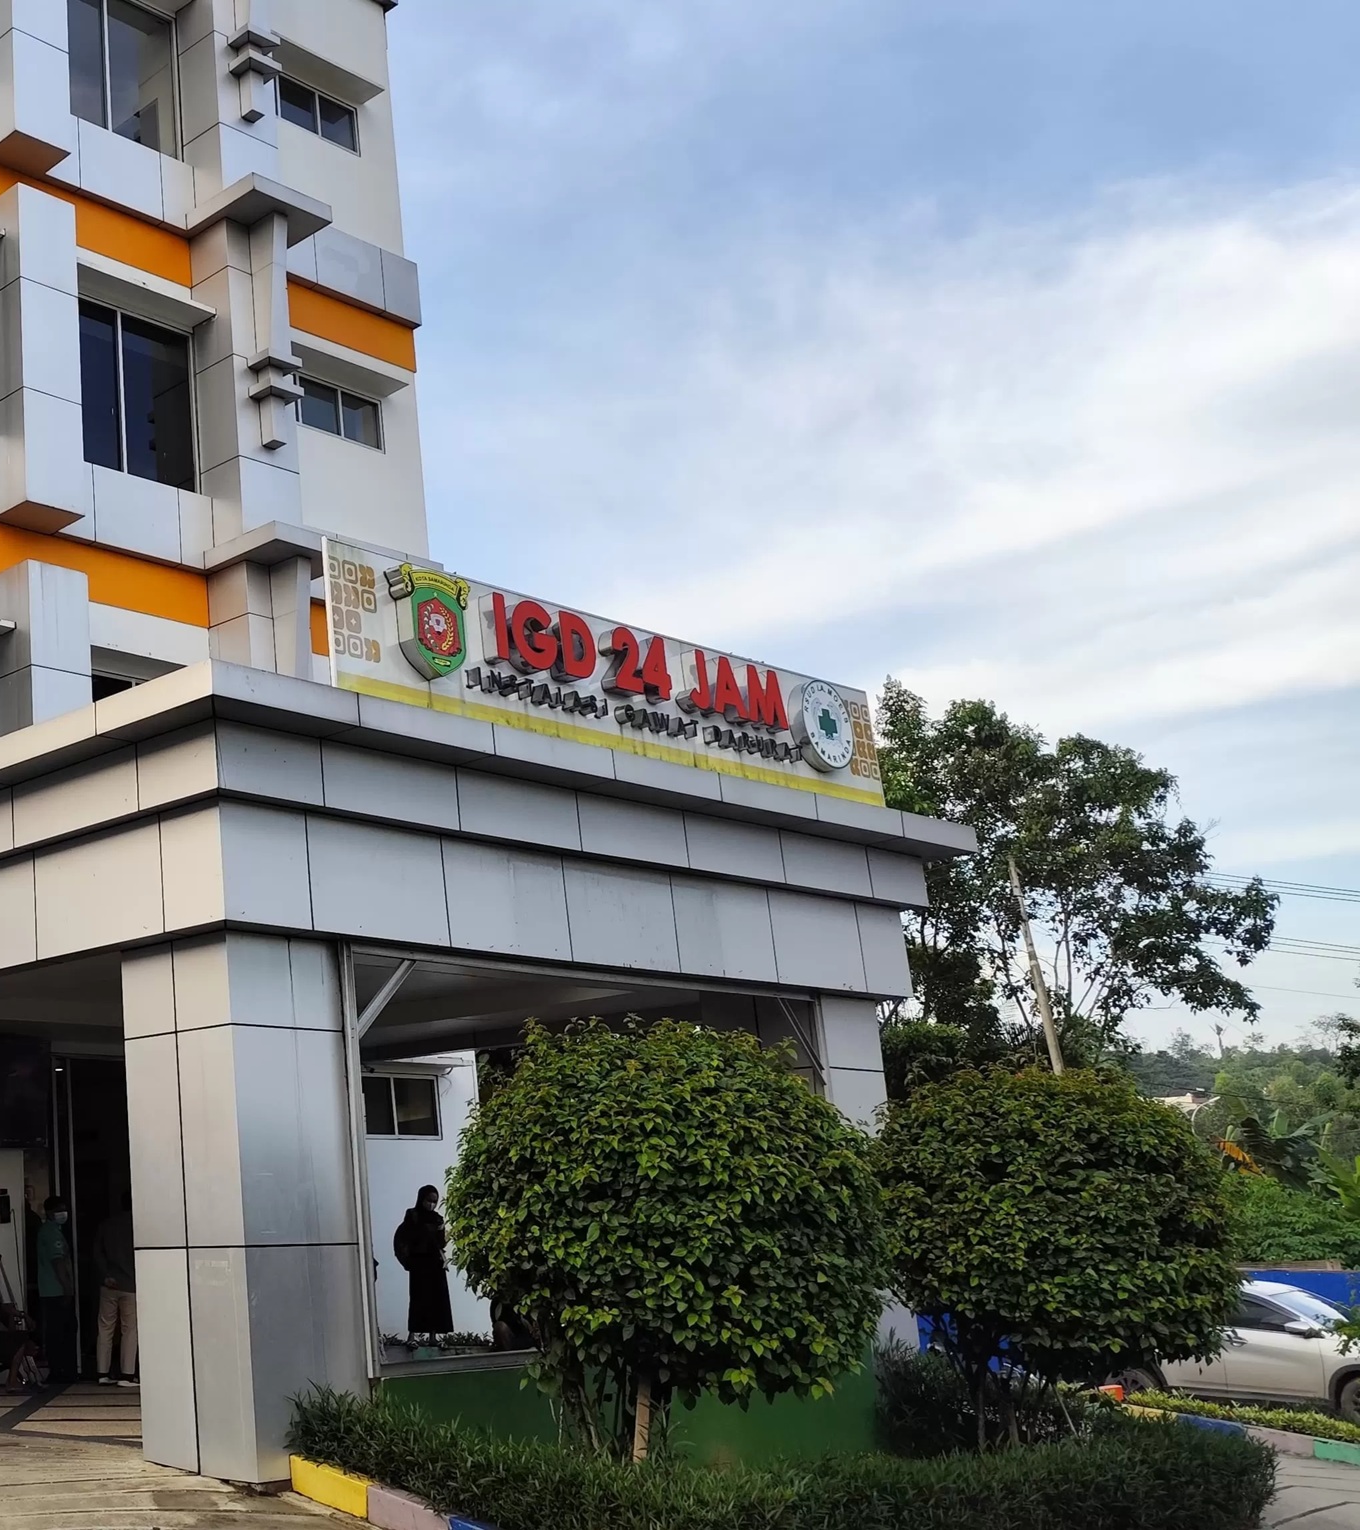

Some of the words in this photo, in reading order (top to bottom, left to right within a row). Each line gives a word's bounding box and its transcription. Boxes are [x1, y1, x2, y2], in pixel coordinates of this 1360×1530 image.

[490, 591, 597, 680] IGD
[608, 626, 672, 701] 24
[689, 648, 789, 731] JAM
[465, 666, 609, 719] INSTALASI
[614, 703, 700, 741] GAWAT
[702, 724, 802, 764] DARURAT
[804, 686, 816, 713] RSUD
[827, 688, 849, 724] MOEIS
[810, 731, 852, 764] SAMARINDA
